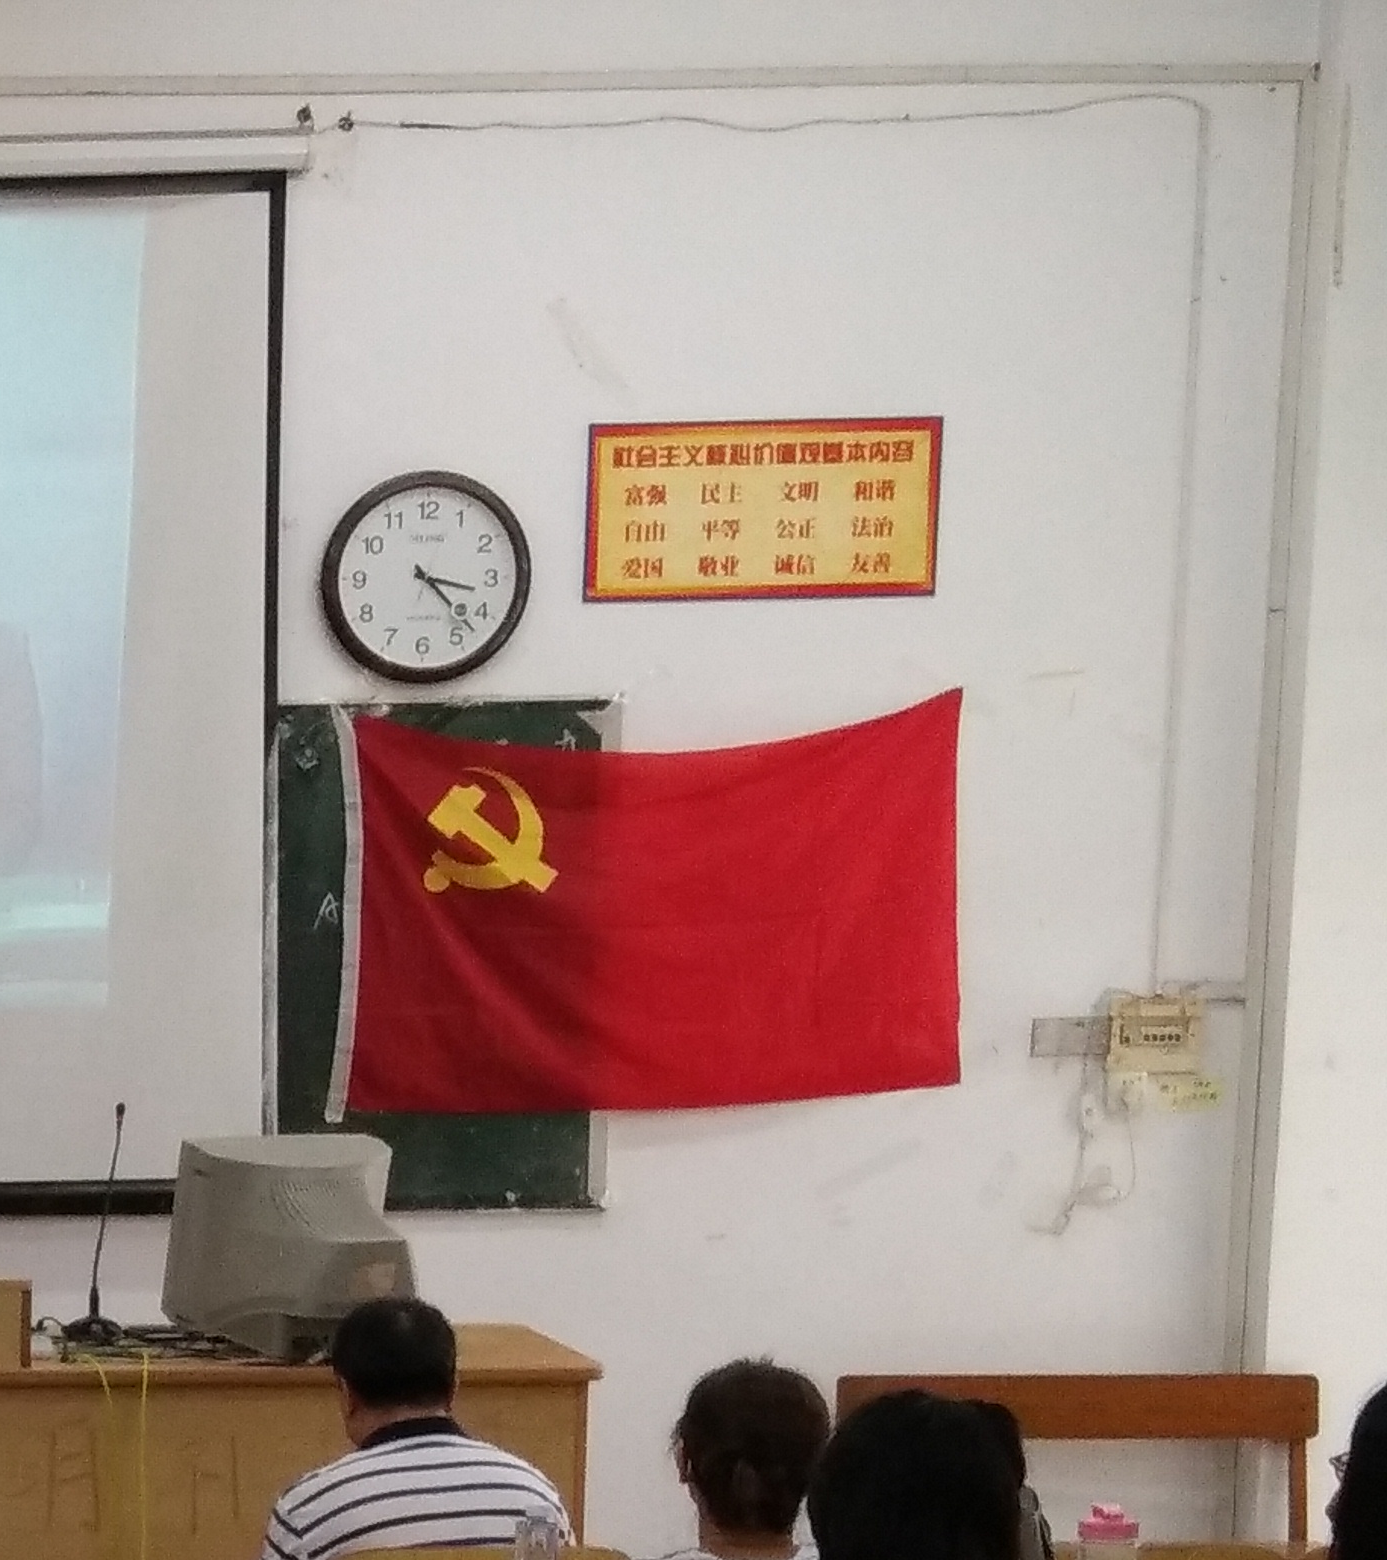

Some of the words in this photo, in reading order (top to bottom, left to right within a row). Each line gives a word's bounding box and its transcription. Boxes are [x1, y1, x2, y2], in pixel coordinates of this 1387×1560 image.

[624, 484, 668, 506] 富强
[701, 482, 743, 505] 民主
[780, 481, 819, 502] 文明
[854, 479, 895, 502] 和谐
[417, 501, 440, 520] 12
[455, 510, 465, 528] 1
[384, 512, 404, 529] 11
[624, 520, 665, 542] 自由
[702, 518, 740, 541] 平等
[776, 517, 816, 539] 公正
[851, 515, 894, 538] 法治
[362, 535, 384, 554] 10
[477, 534, 493, 553] 2
[621, 557, 663, 579] 爱国
[697, 554, 739, 577] 敬业
[773, 553, 815, 576] 诚信
[851, 551, 891, 574] 友善
[352, 570, 368, 590] 9
[484, 568, 499, 588] 3
[359, 603, 374, 623] 8
[474, 601, 489, 620] 4
[384, 628, 399, 646] 7
[415, 636, 430, 655] 6
[449, 626, 464, 646] 5
